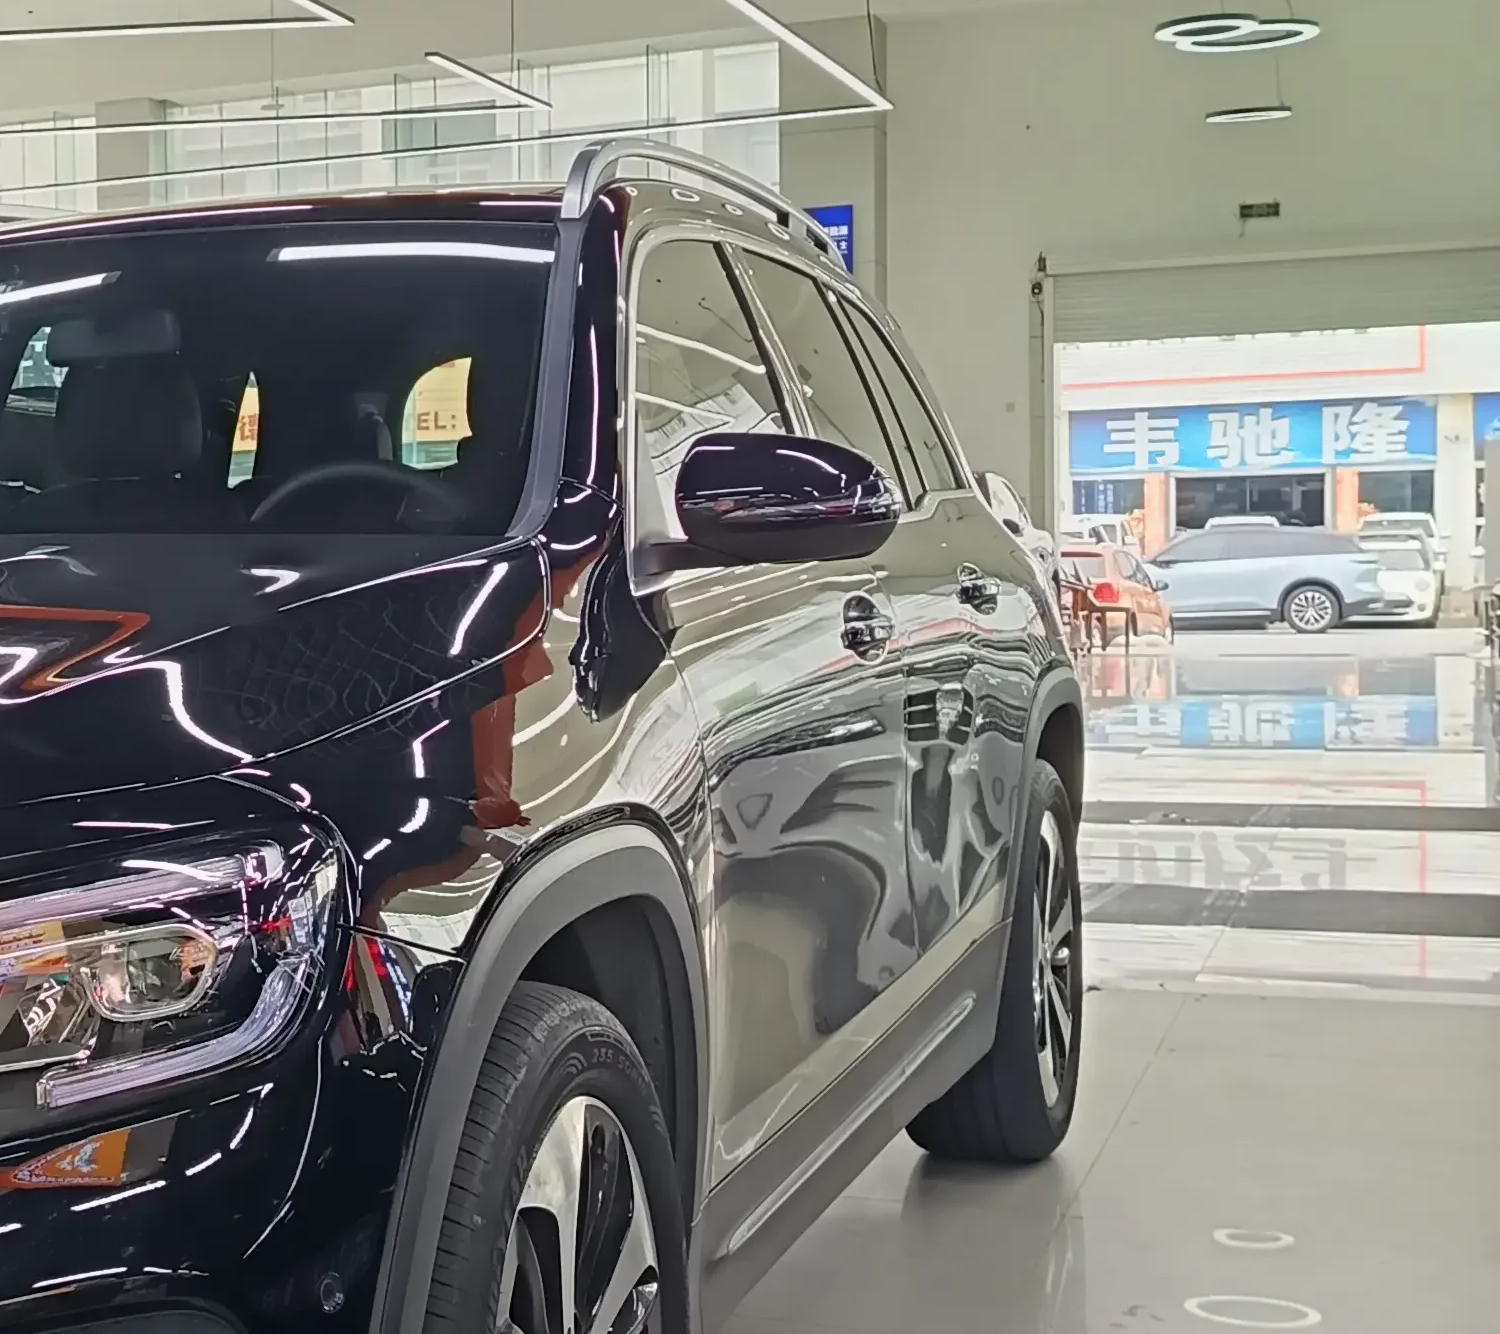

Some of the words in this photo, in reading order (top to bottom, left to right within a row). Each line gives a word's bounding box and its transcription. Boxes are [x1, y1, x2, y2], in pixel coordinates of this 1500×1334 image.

[406, 411, 456, 431] EL:
[1103, 401, 1409, 469] 韦驰隆
